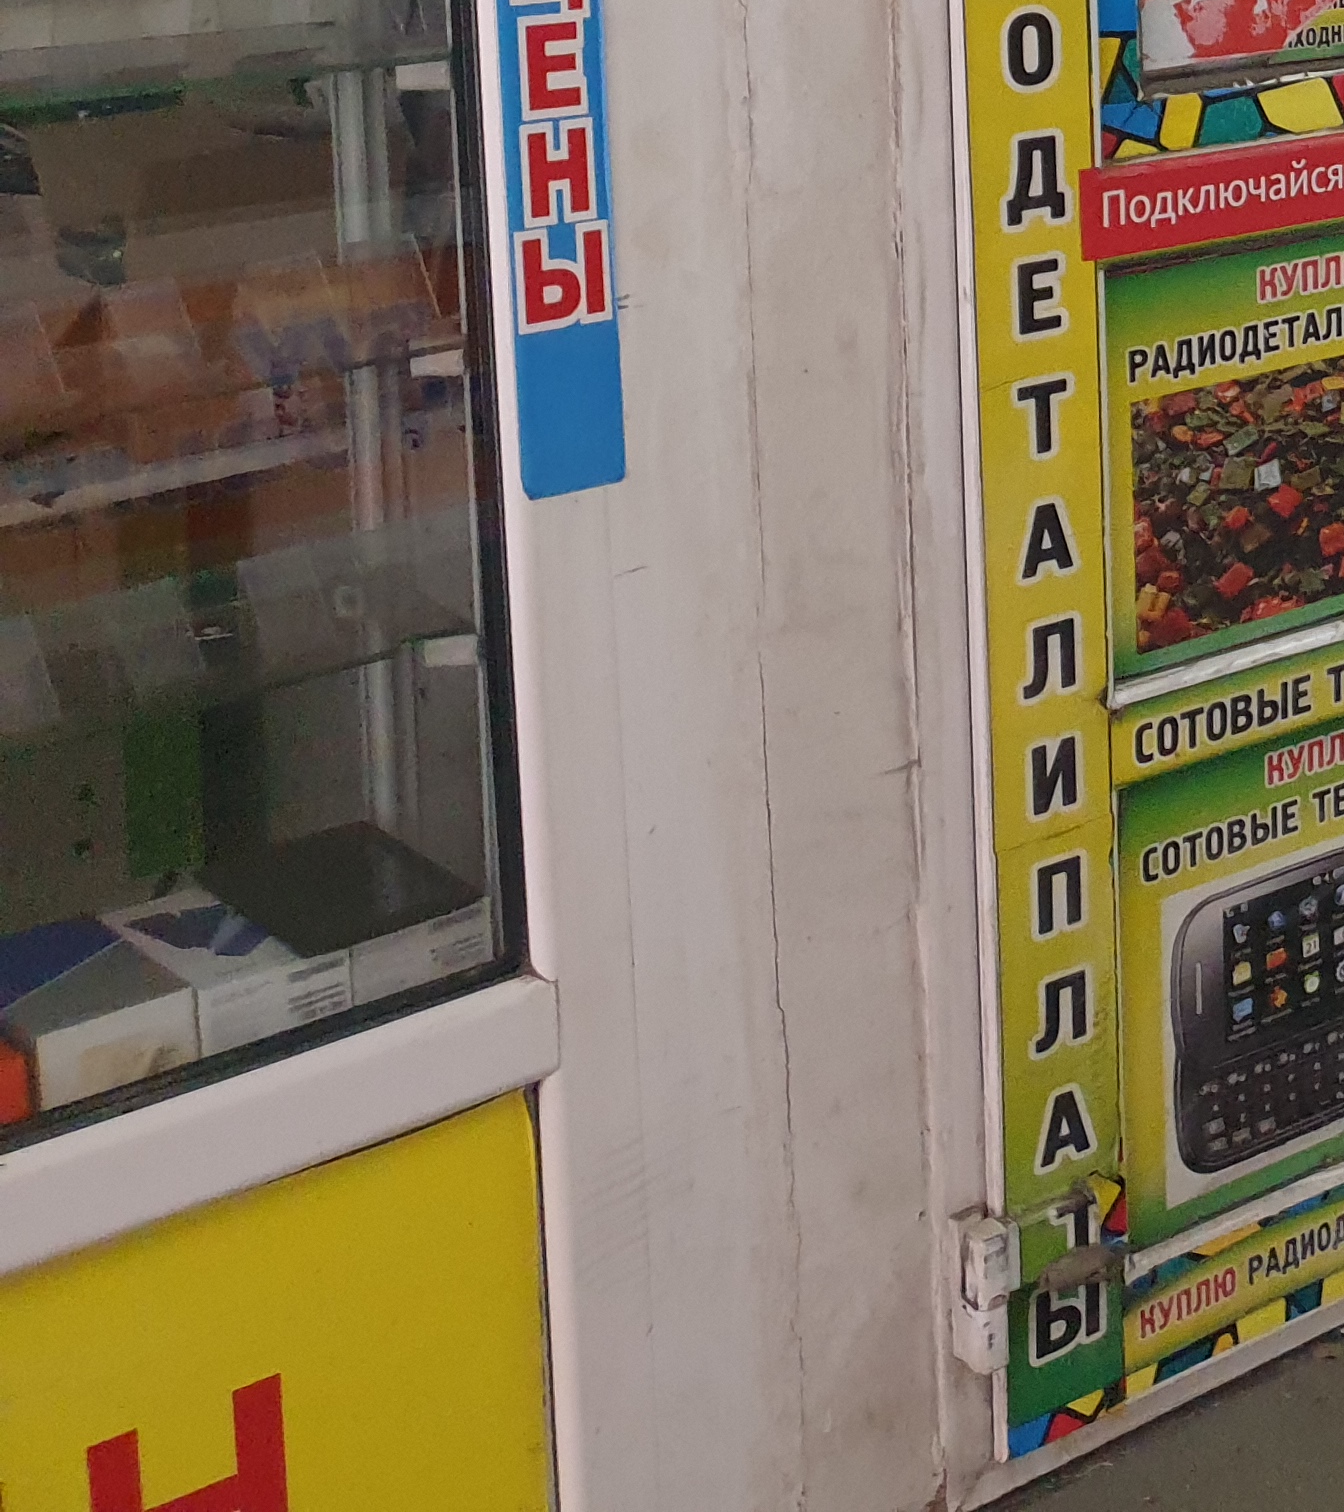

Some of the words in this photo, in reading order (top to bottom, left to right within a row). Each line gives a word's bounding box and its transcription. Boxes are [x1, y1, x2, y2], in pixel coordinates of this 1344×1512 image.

[1103, 157, 1344, 228] Подключайся
[1135, 675, 1311, 763] СОТОВЫЕ
[1143, 799, 1299, 882] СОТОВЫЕ
[1139, 1267, 1236, 1338] КУПЛЮ
